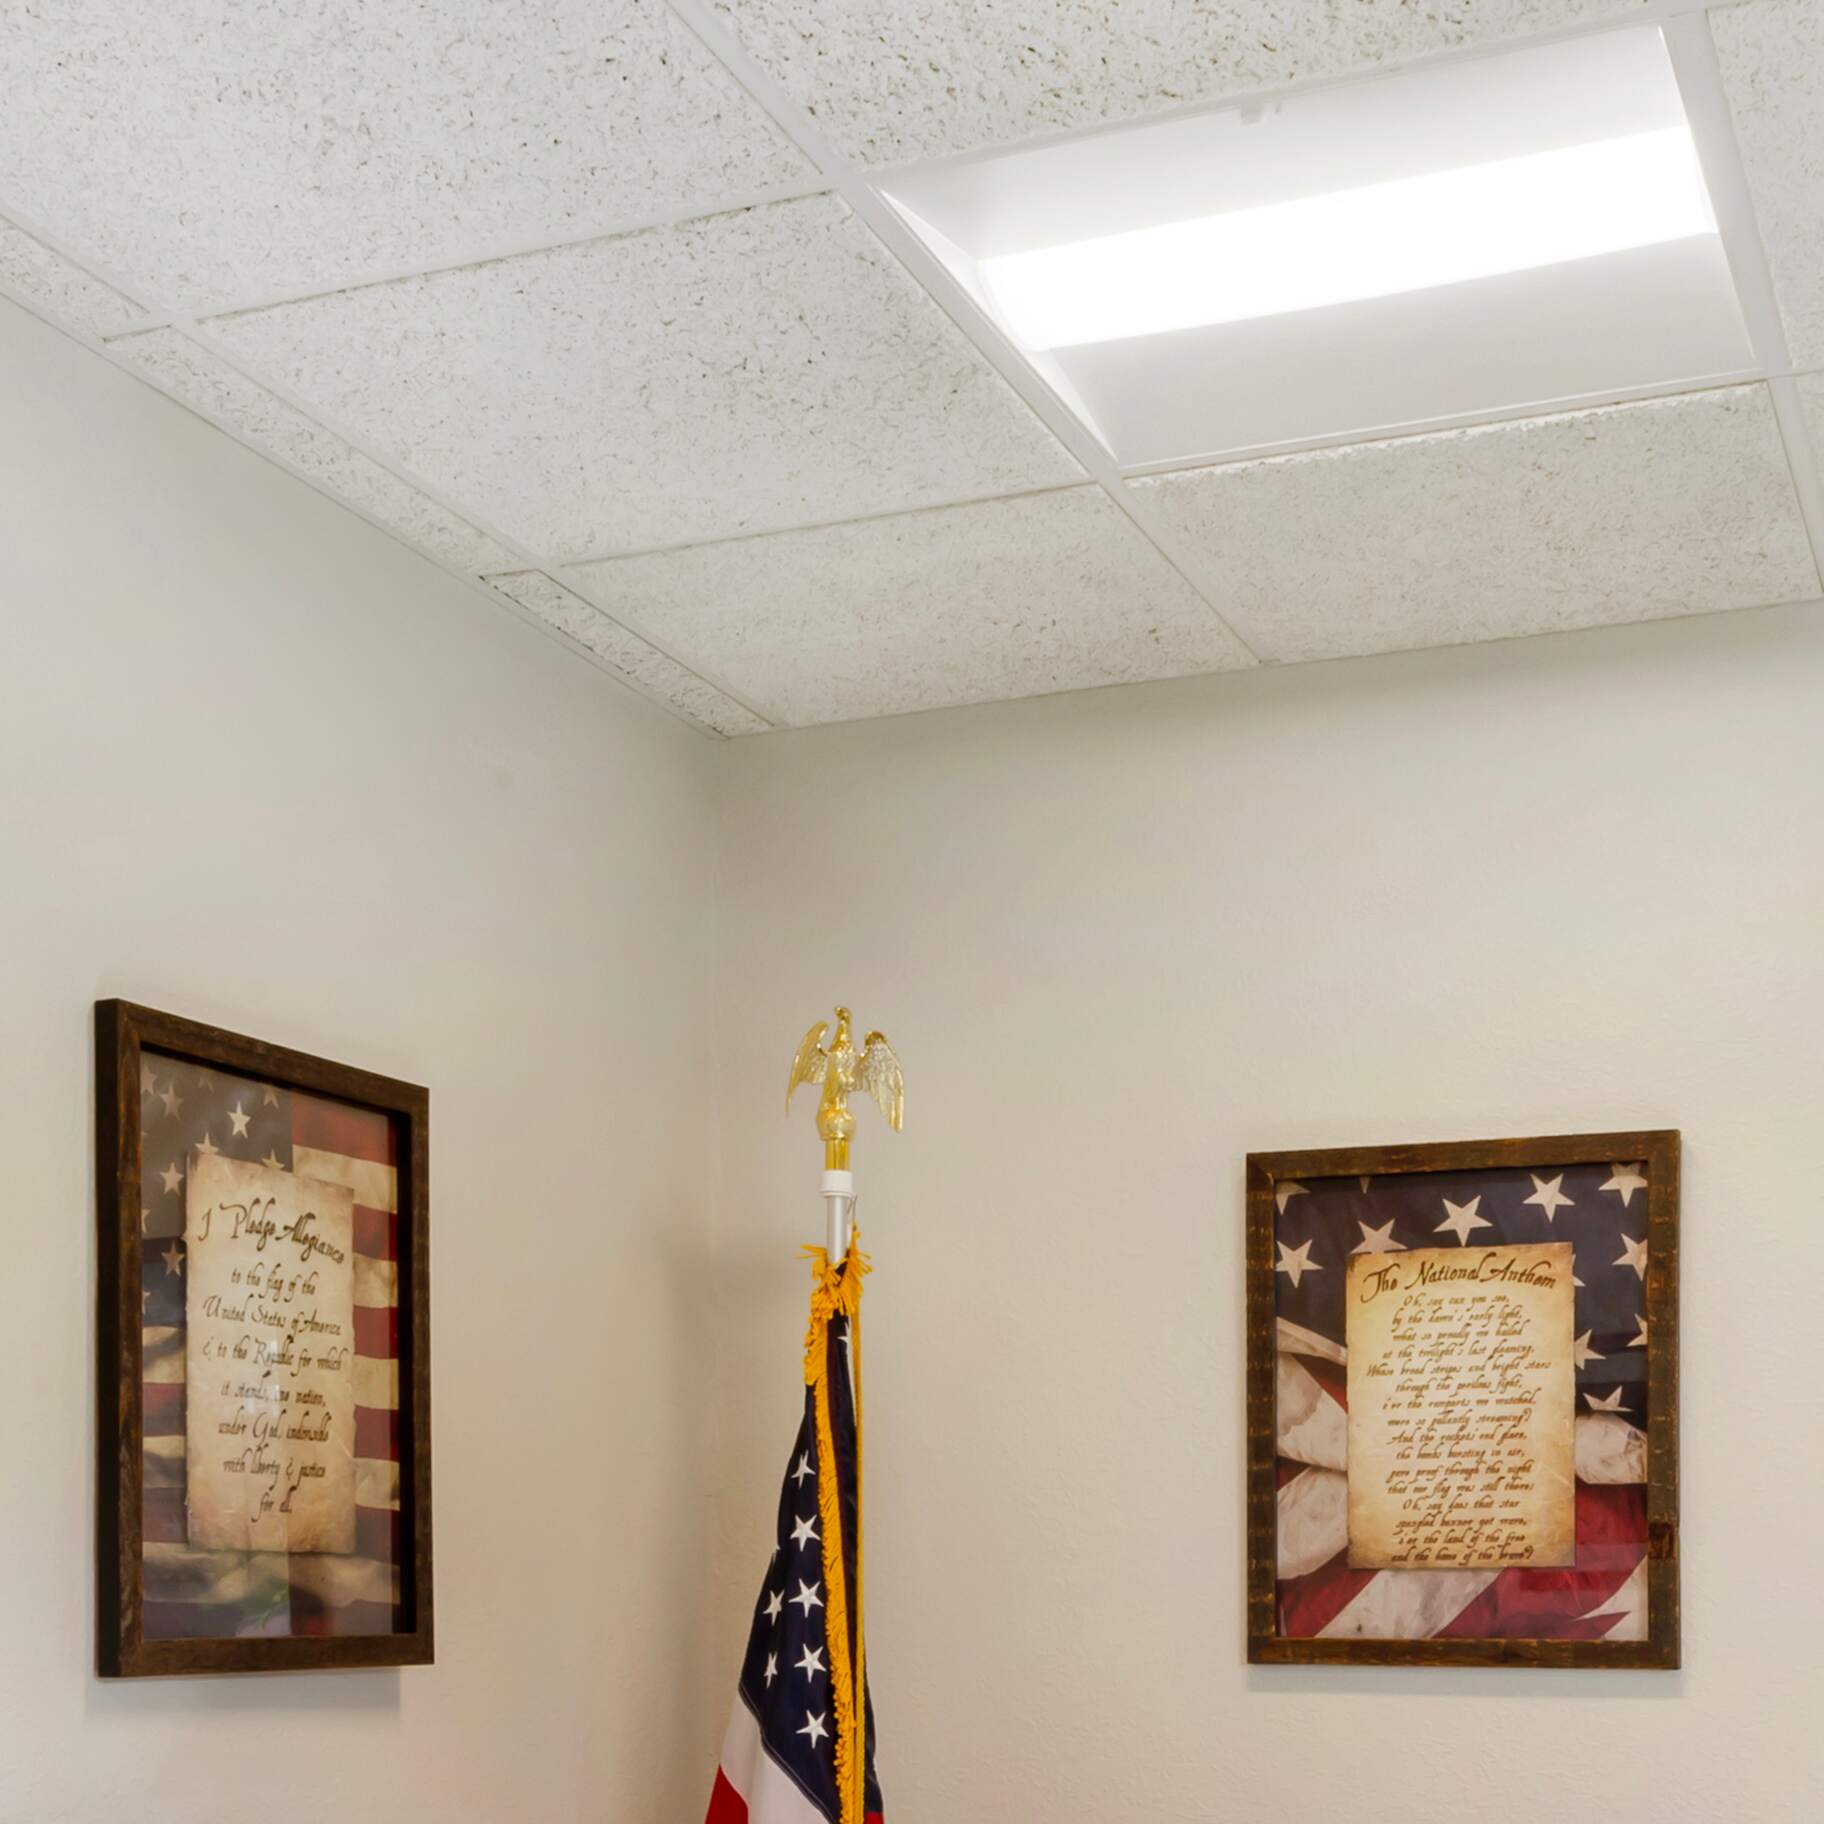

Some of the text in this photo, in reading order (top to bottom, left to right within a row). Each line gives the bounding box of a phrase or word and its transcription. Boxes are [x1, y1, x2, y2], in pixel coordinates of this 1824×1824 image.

[220, 1198, 276, 1251] Pledge
[276, 1213, 344, 1264] Allegiance
[247, 1262, 264, 1286] the
[302, 1271, 318, 1295] the
[1361, 1252, 1555, 1303] The National Anthem
[203, 1294, 254, 1321] United
[251, 1305, 286, 1328] States
[299, 1309, 341, 1335] America
